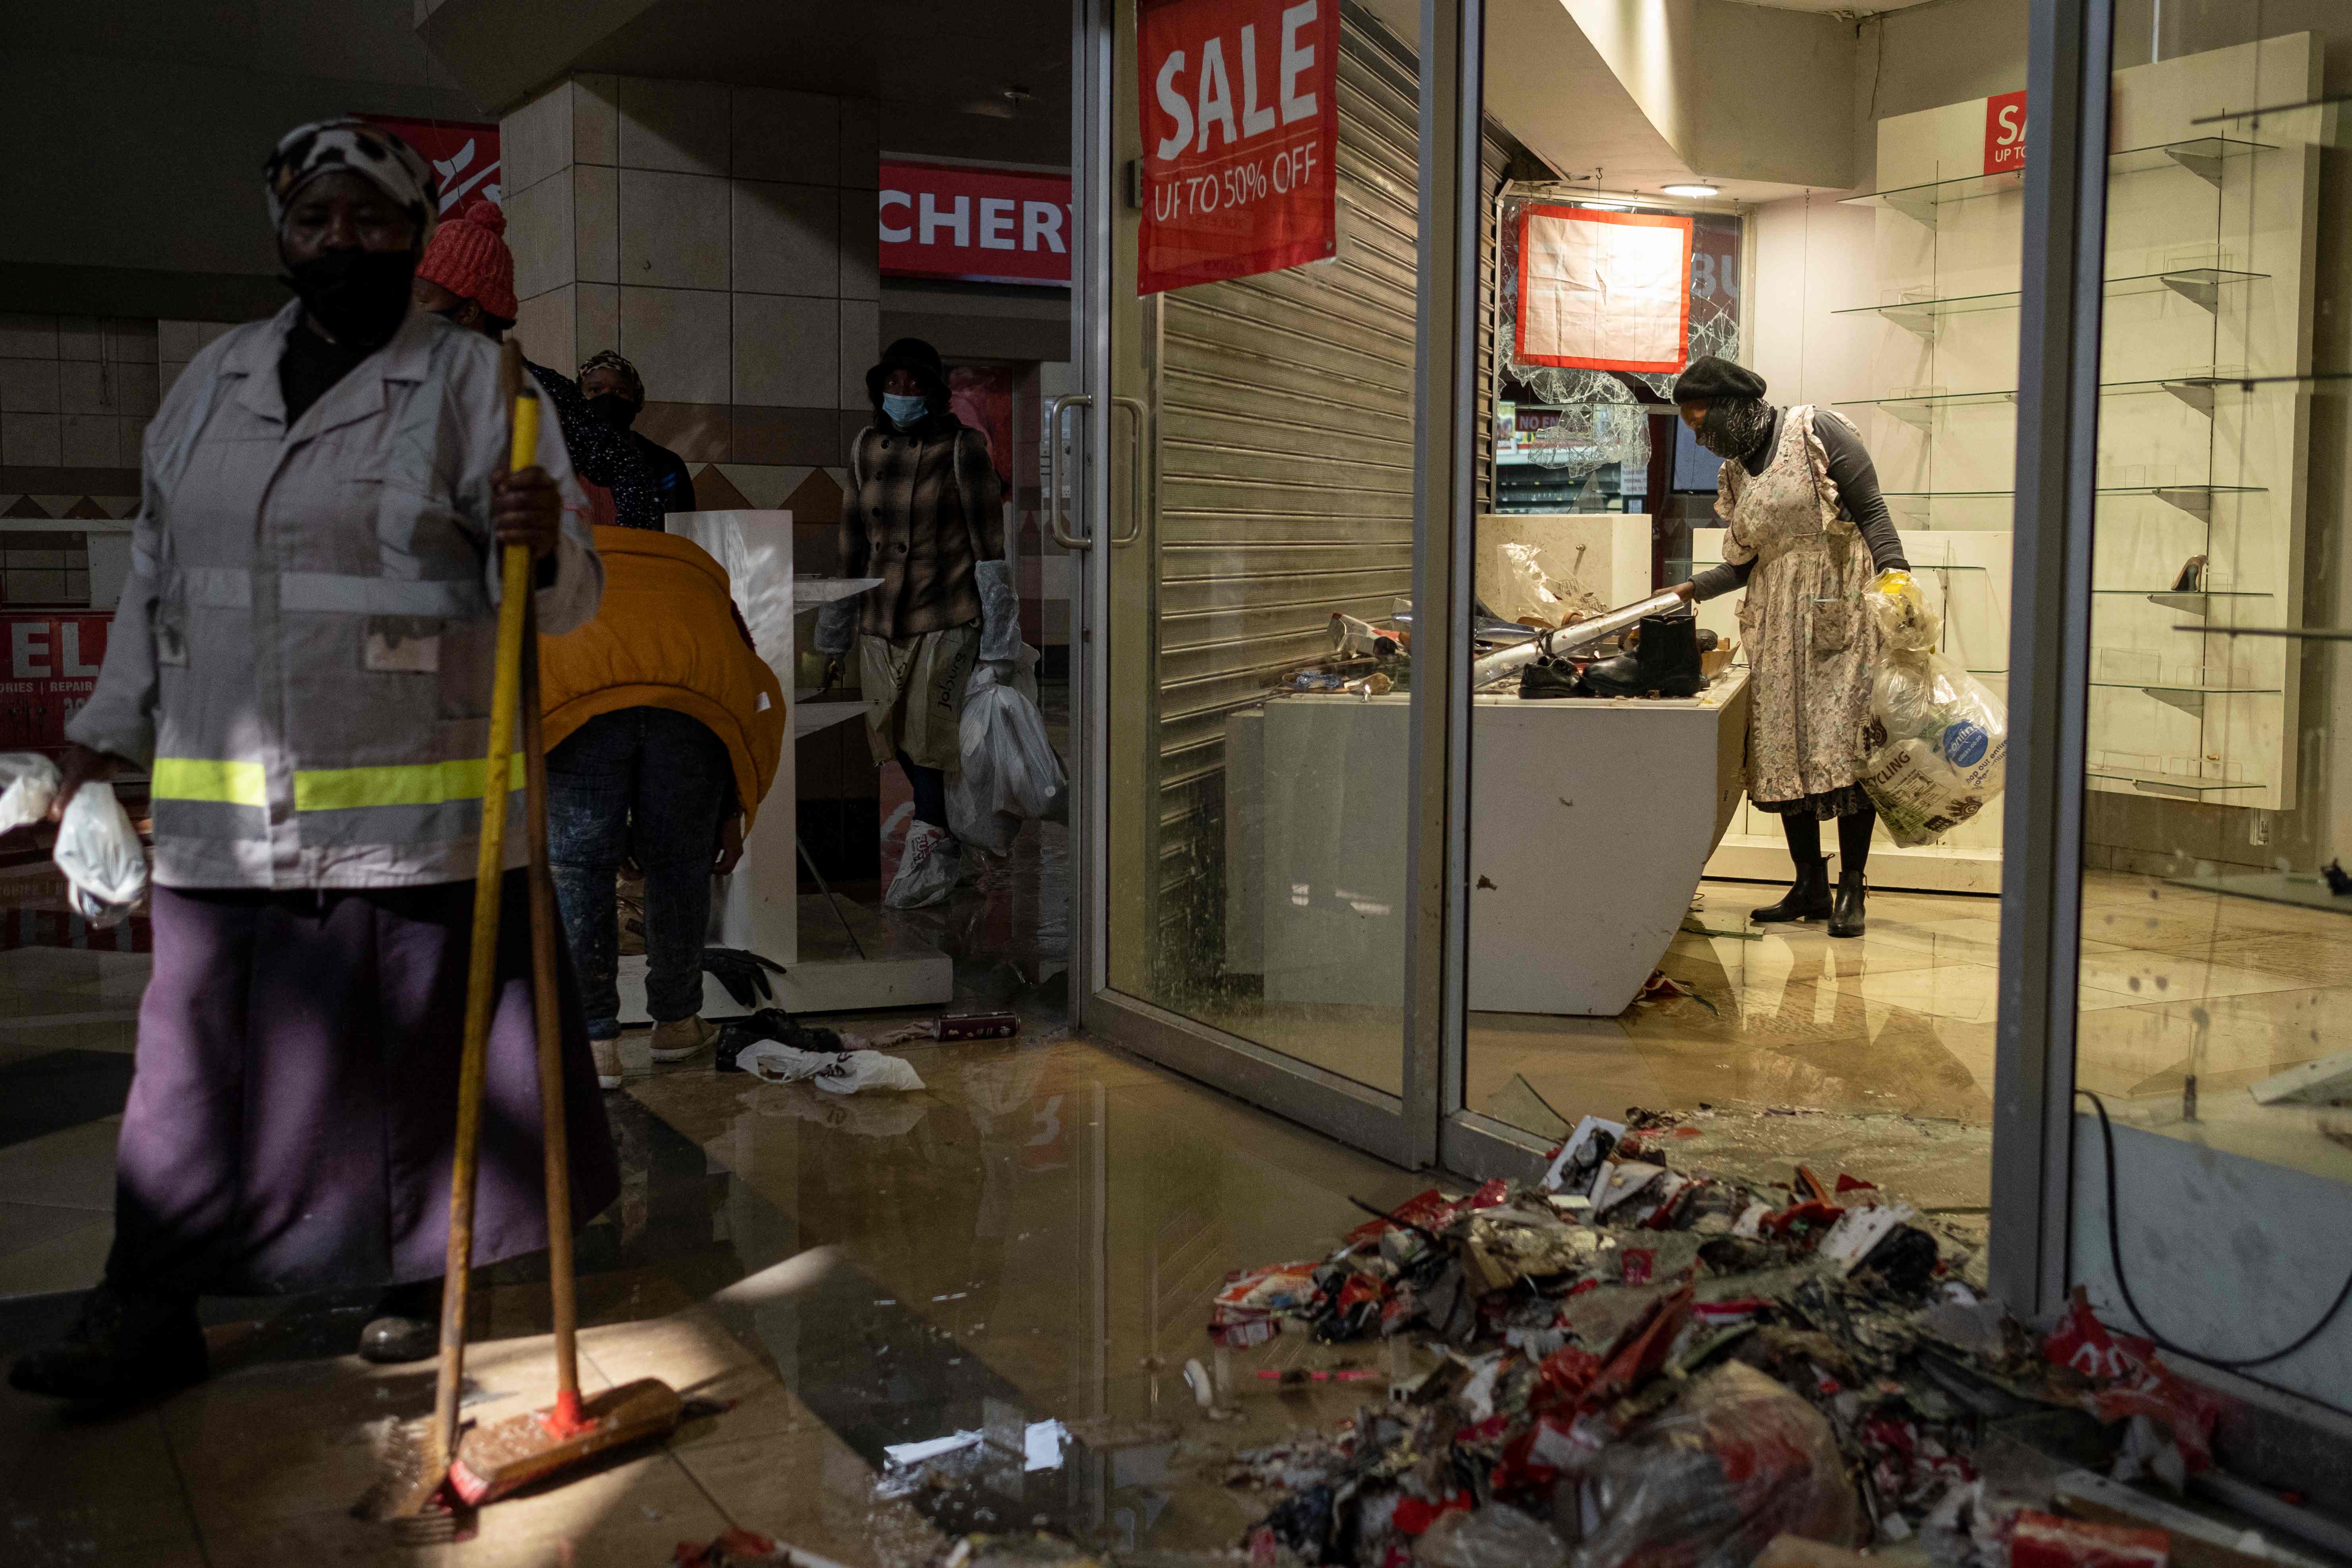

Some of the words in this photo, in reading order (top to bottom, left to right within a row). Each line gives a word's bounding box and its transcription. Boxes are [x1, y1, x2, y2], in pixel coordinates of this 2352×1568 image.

[1155, 0, 1318, 161] SALE
[1186, 174, 1219, 215] TO
[1224, 159, 1266, 209] 50%
[1273, 141, 1316, 194] OFF
[1995, 148, 2011, 162] UP
[878, 189, 1072, 254] CHER
[1519, 416, 1539, 429] NO
[11, 622, 114, 679] EL
[938, 653, 966, 711] Joburg
[1978, 758, 1991, 771] our
